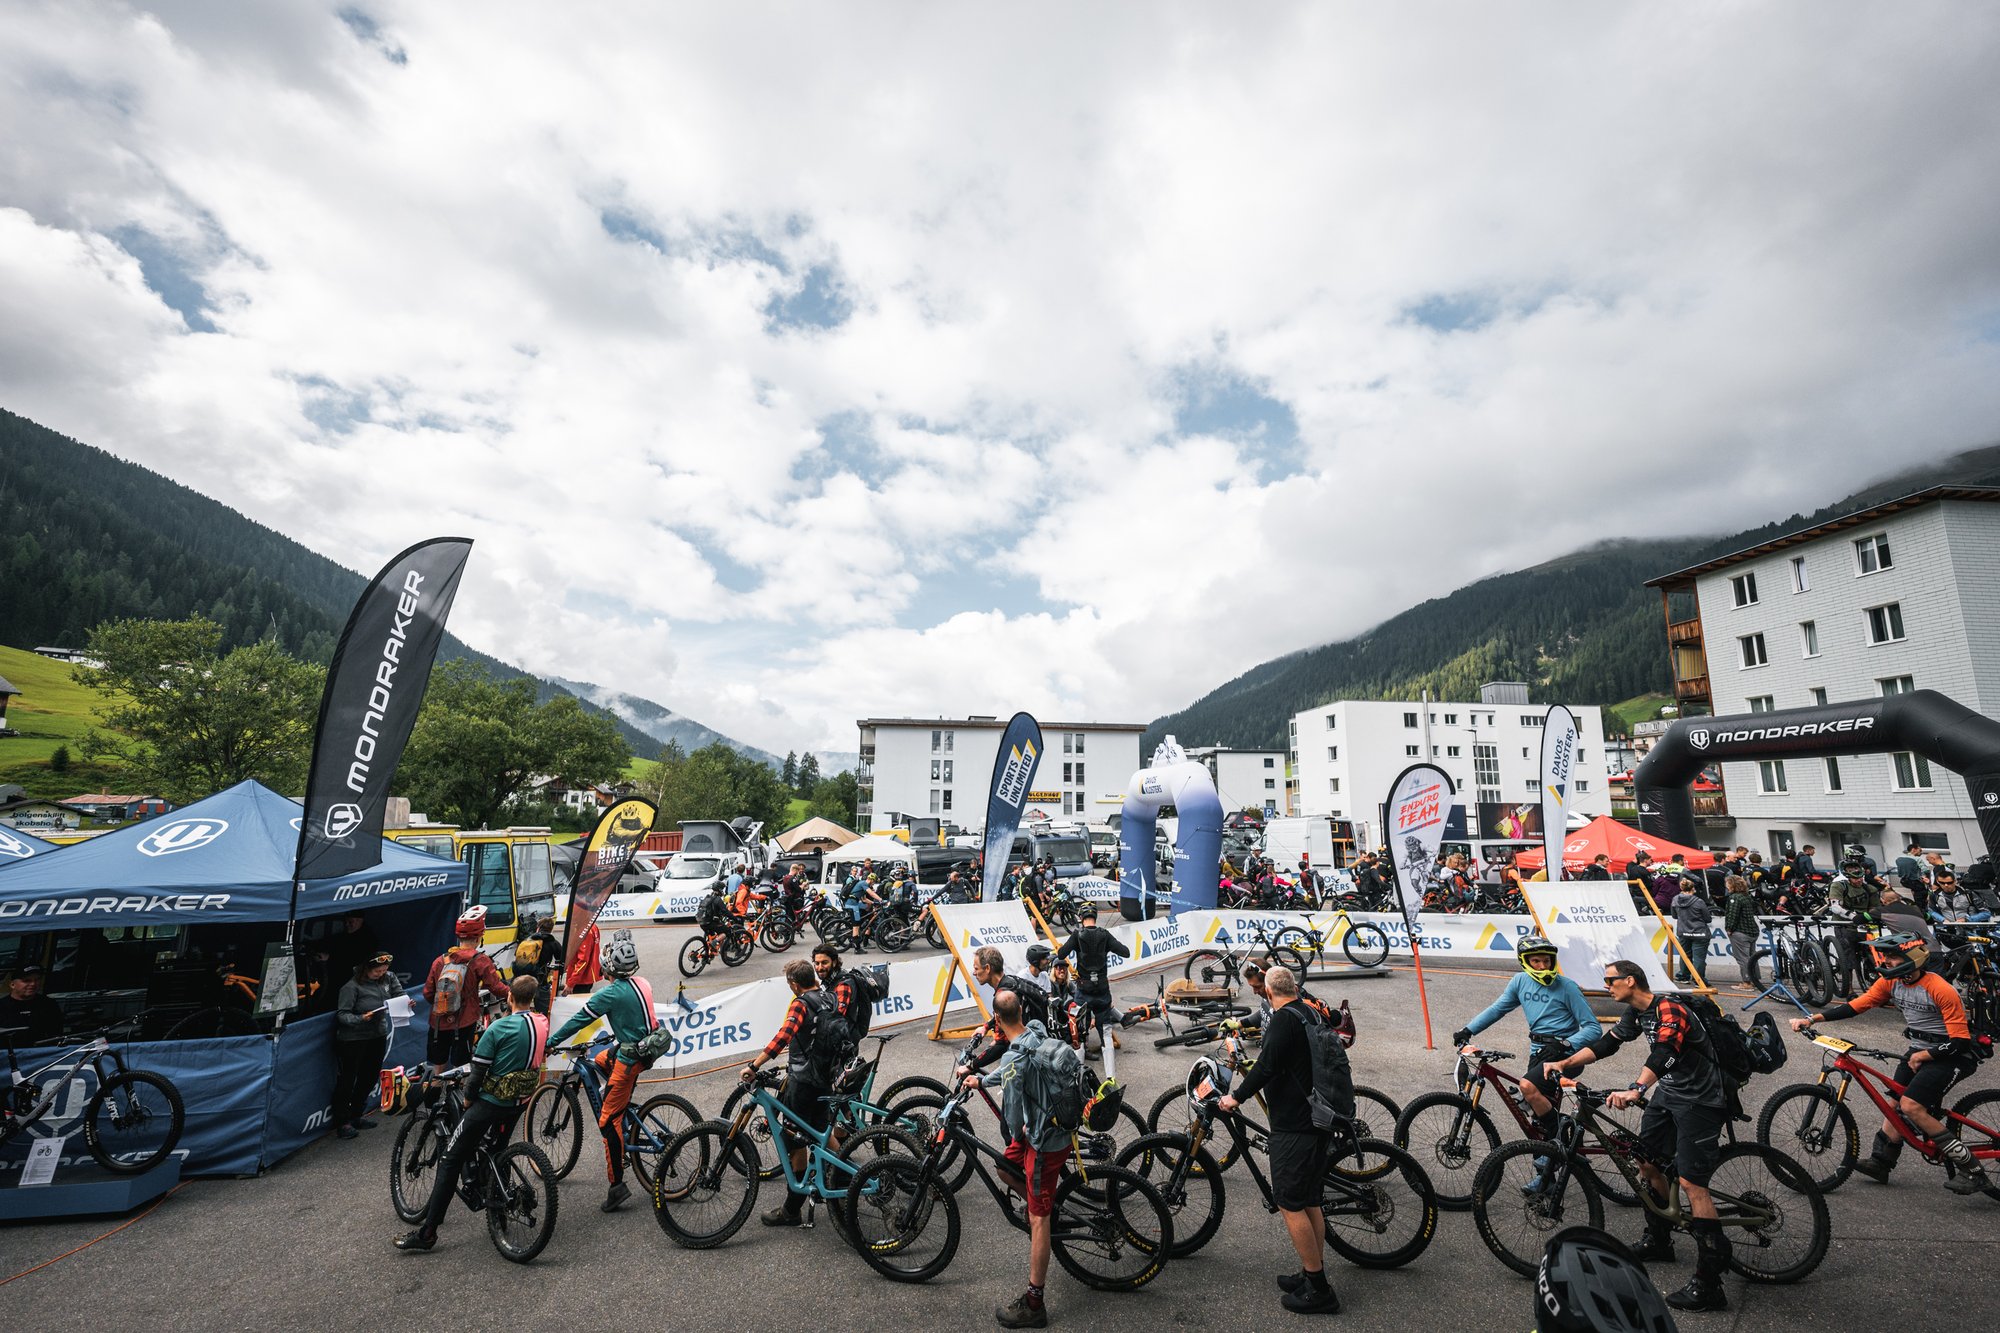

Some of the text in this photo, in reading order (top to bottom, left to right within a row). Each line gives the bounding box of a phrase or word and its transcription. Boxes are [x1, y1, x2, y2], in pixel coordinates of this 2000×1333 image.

[346, 570, 425, 793] MONDRAKER
[1716, 717, 1874, 743] MONDRAKER
[1552, 737, 1564, 776] DAVOS
[1560, 727, 1575, 781] KLOSTERS
[1000, 759, 1018, 797] SPORTS
[1009, 754, 1032, 804] UNLIMITED
[1266, 809, 1272, 817] P
[1398, 802, 1439, 828] TEAM
[1400, 792, 1439, 815] ENDURO
[597, 844, 625, 860] BIKE
[333, 873, 448, 901] MONDRAKER
[0, 894, 231, 918] ONDRAKER
[1570, 905, 1605, 914] DAVOS
[1236, 919, 1286, 930] DAVOS
[1573, 914, 1626, 923] KLOSTERS
[984, 934, 1028, 945] KLOSTERS
[1150, 924, 1179, 940] DAVOS
[1153, 934, 1189, 955] KLOSTERS
[1423, 1206, 1433, 1239] MAXXIS
